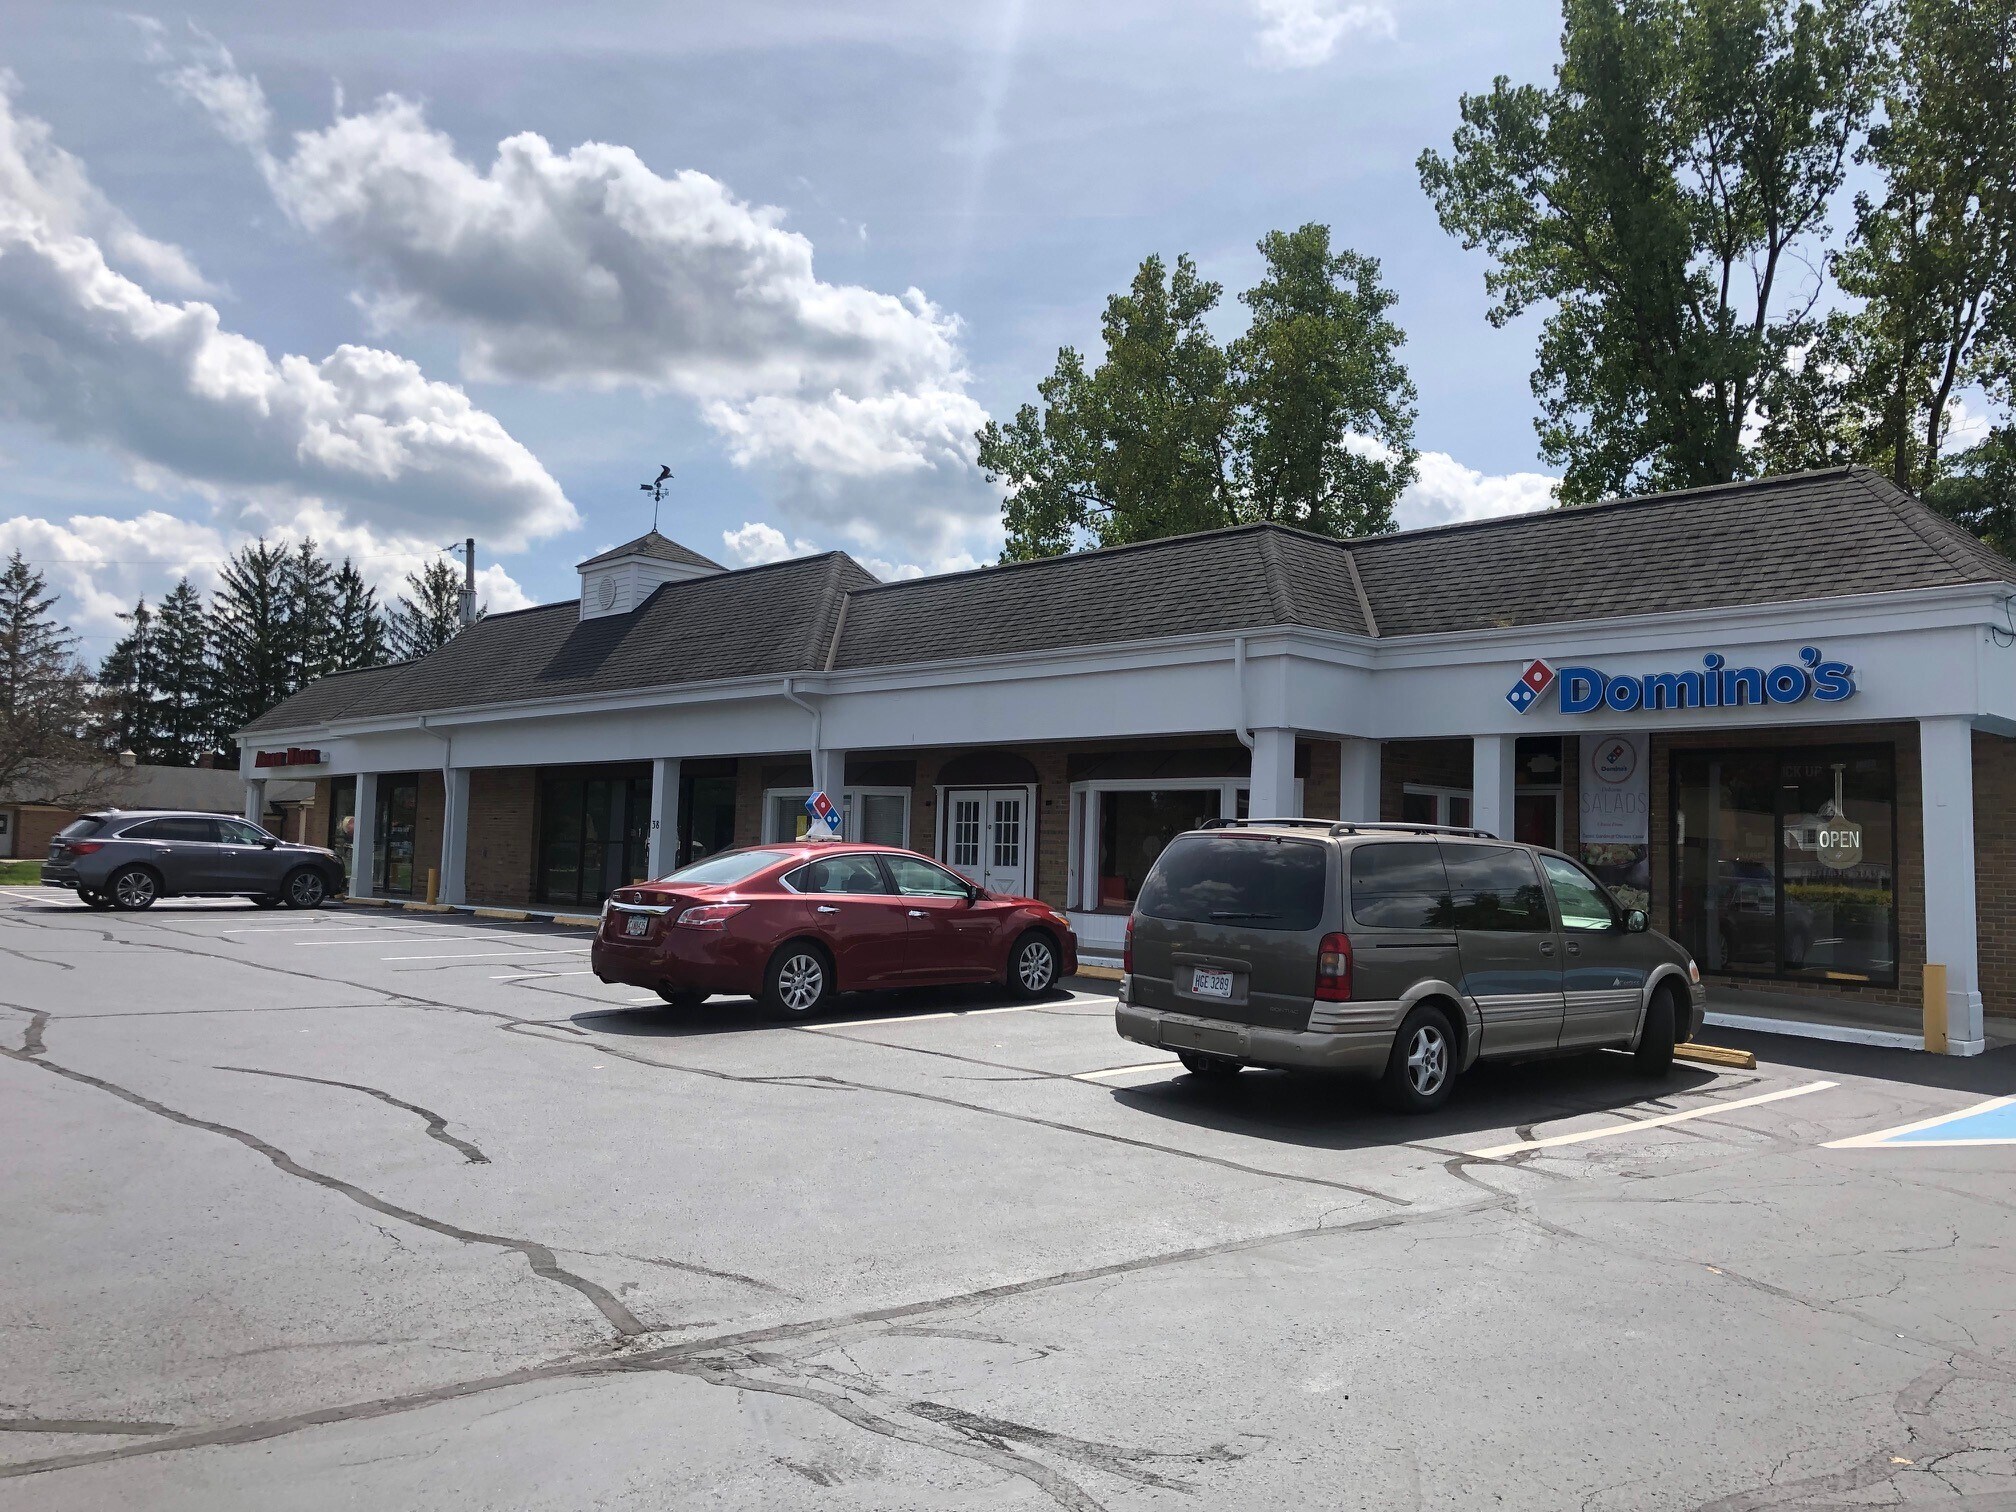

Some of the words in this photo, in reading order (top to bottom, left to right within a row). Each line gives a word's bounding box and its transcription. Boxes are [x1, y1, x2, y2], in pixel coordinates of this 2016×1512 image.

[1558, 646, 1855, 714] Domino's
[1581, 792, 1647, 814] SALADS
[652, 820, 660, 830] 38
[1819, 830, 1860, 848] OPEN
[1195, 974, 1210, 988] HGE
[1210, 976, 1230, 991] 3289
